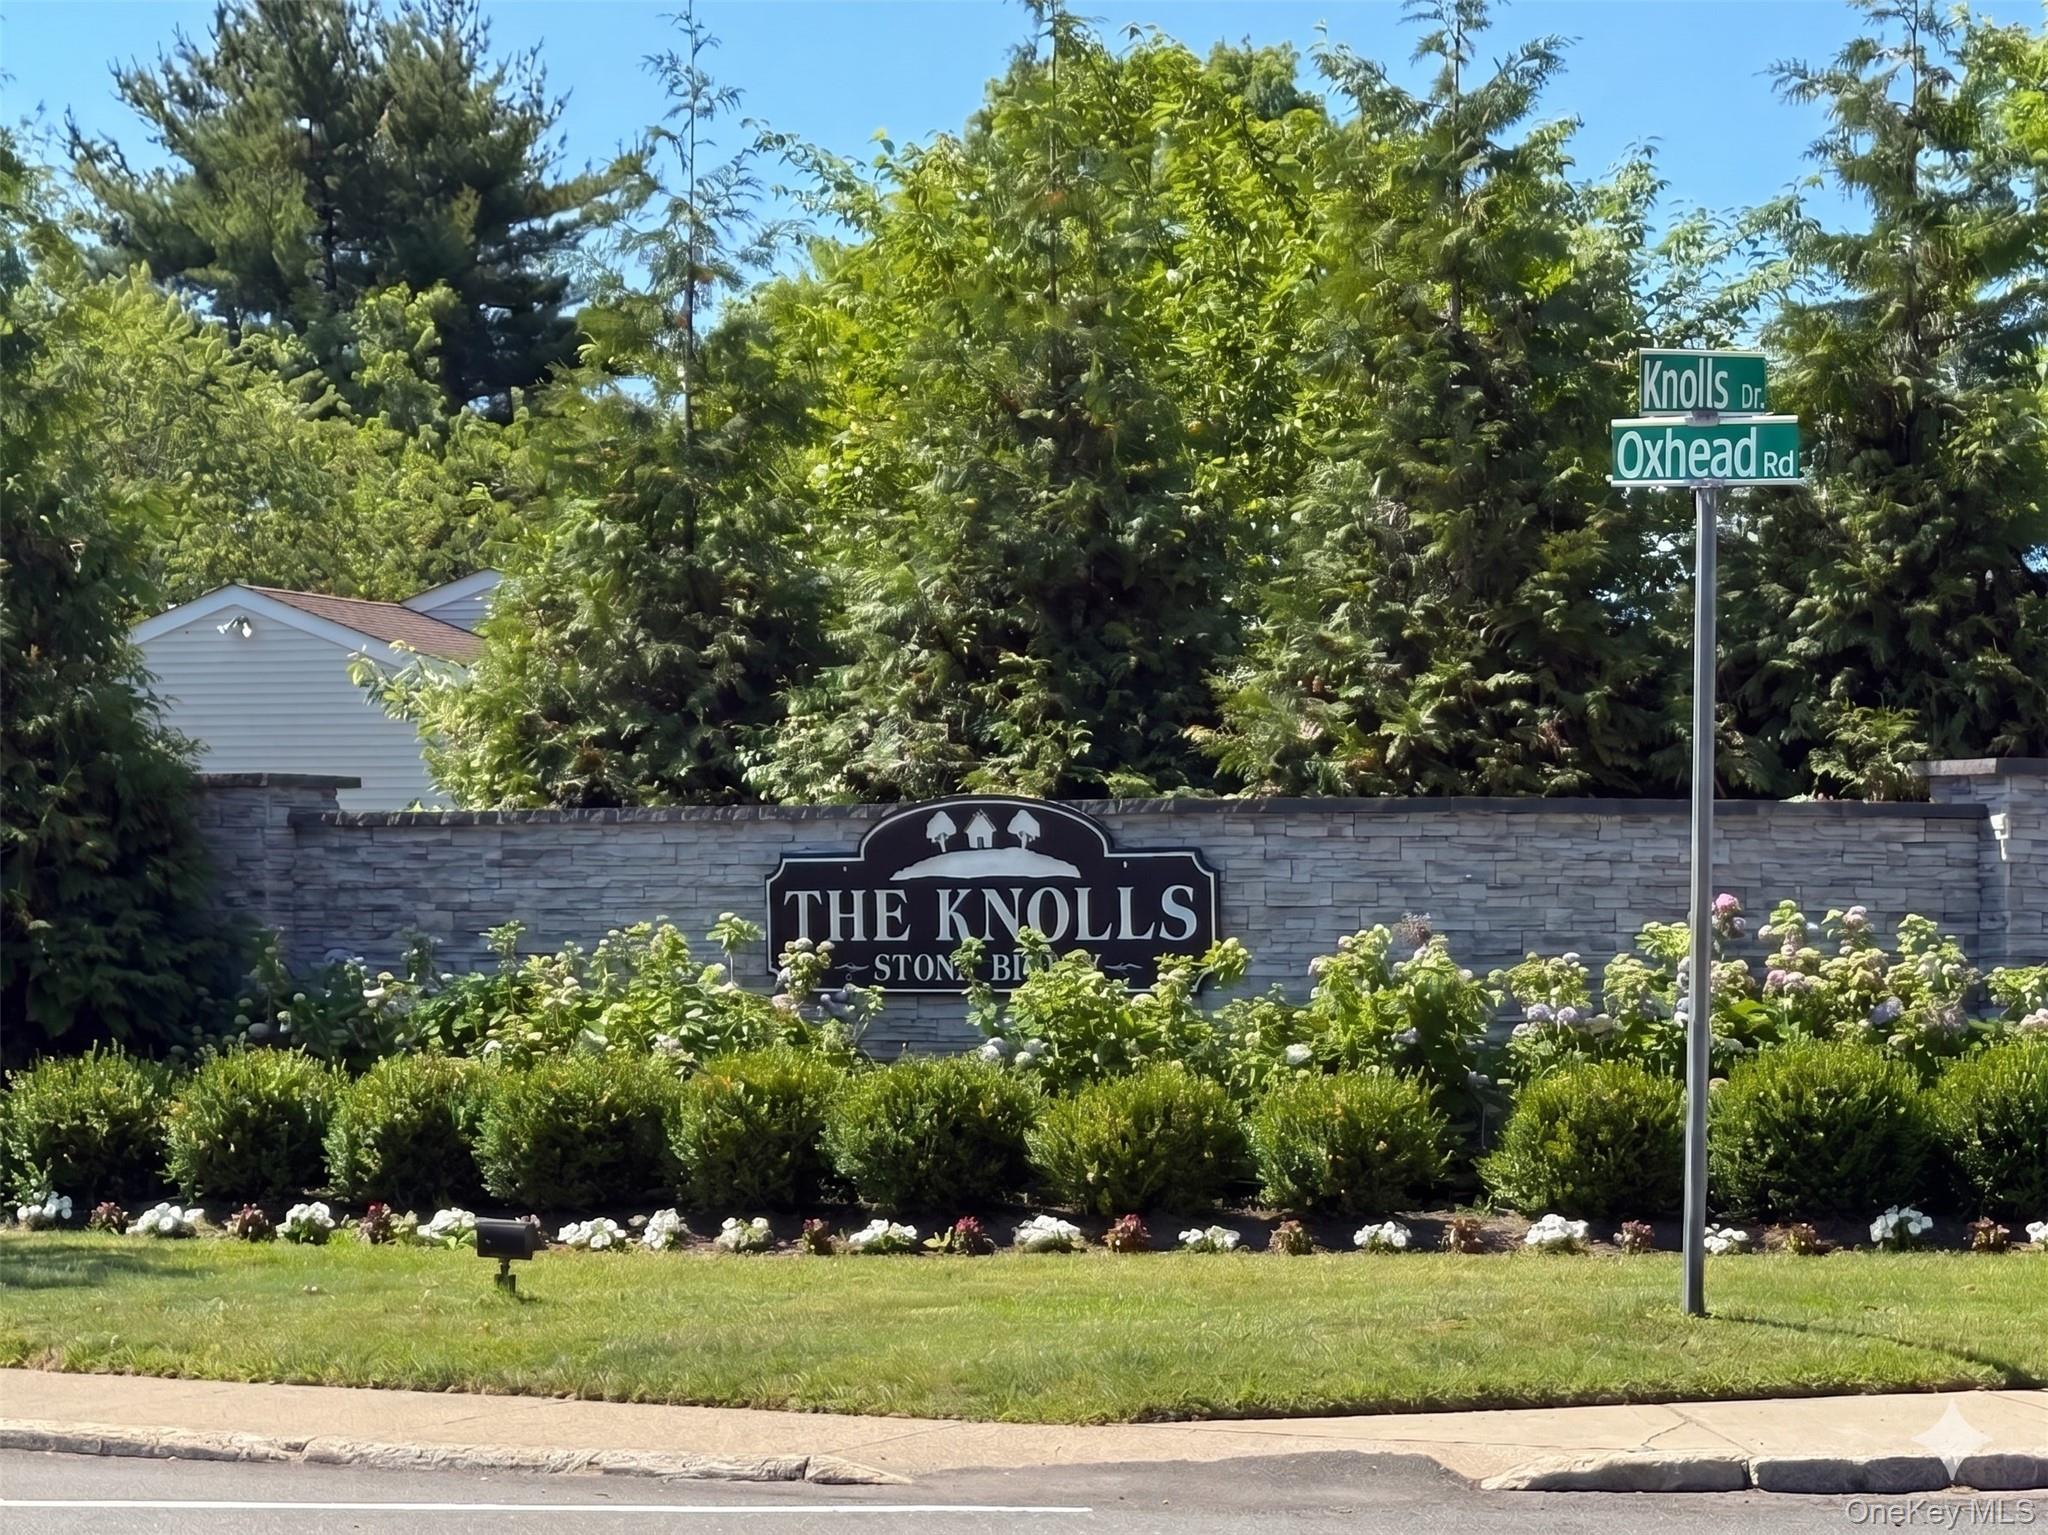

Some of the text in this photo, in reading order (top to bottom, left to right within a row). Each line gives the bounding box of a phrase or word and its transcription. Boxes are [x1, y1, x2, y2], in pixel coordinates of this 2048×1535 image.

[1643, 357, 1765, 410] Knolls Dr.
[1617, 426, 1794, 479] Oxhead Rd
[784, 885, 1198, 943] THE KNOLLS
[873, 953, 980, 982] STON
